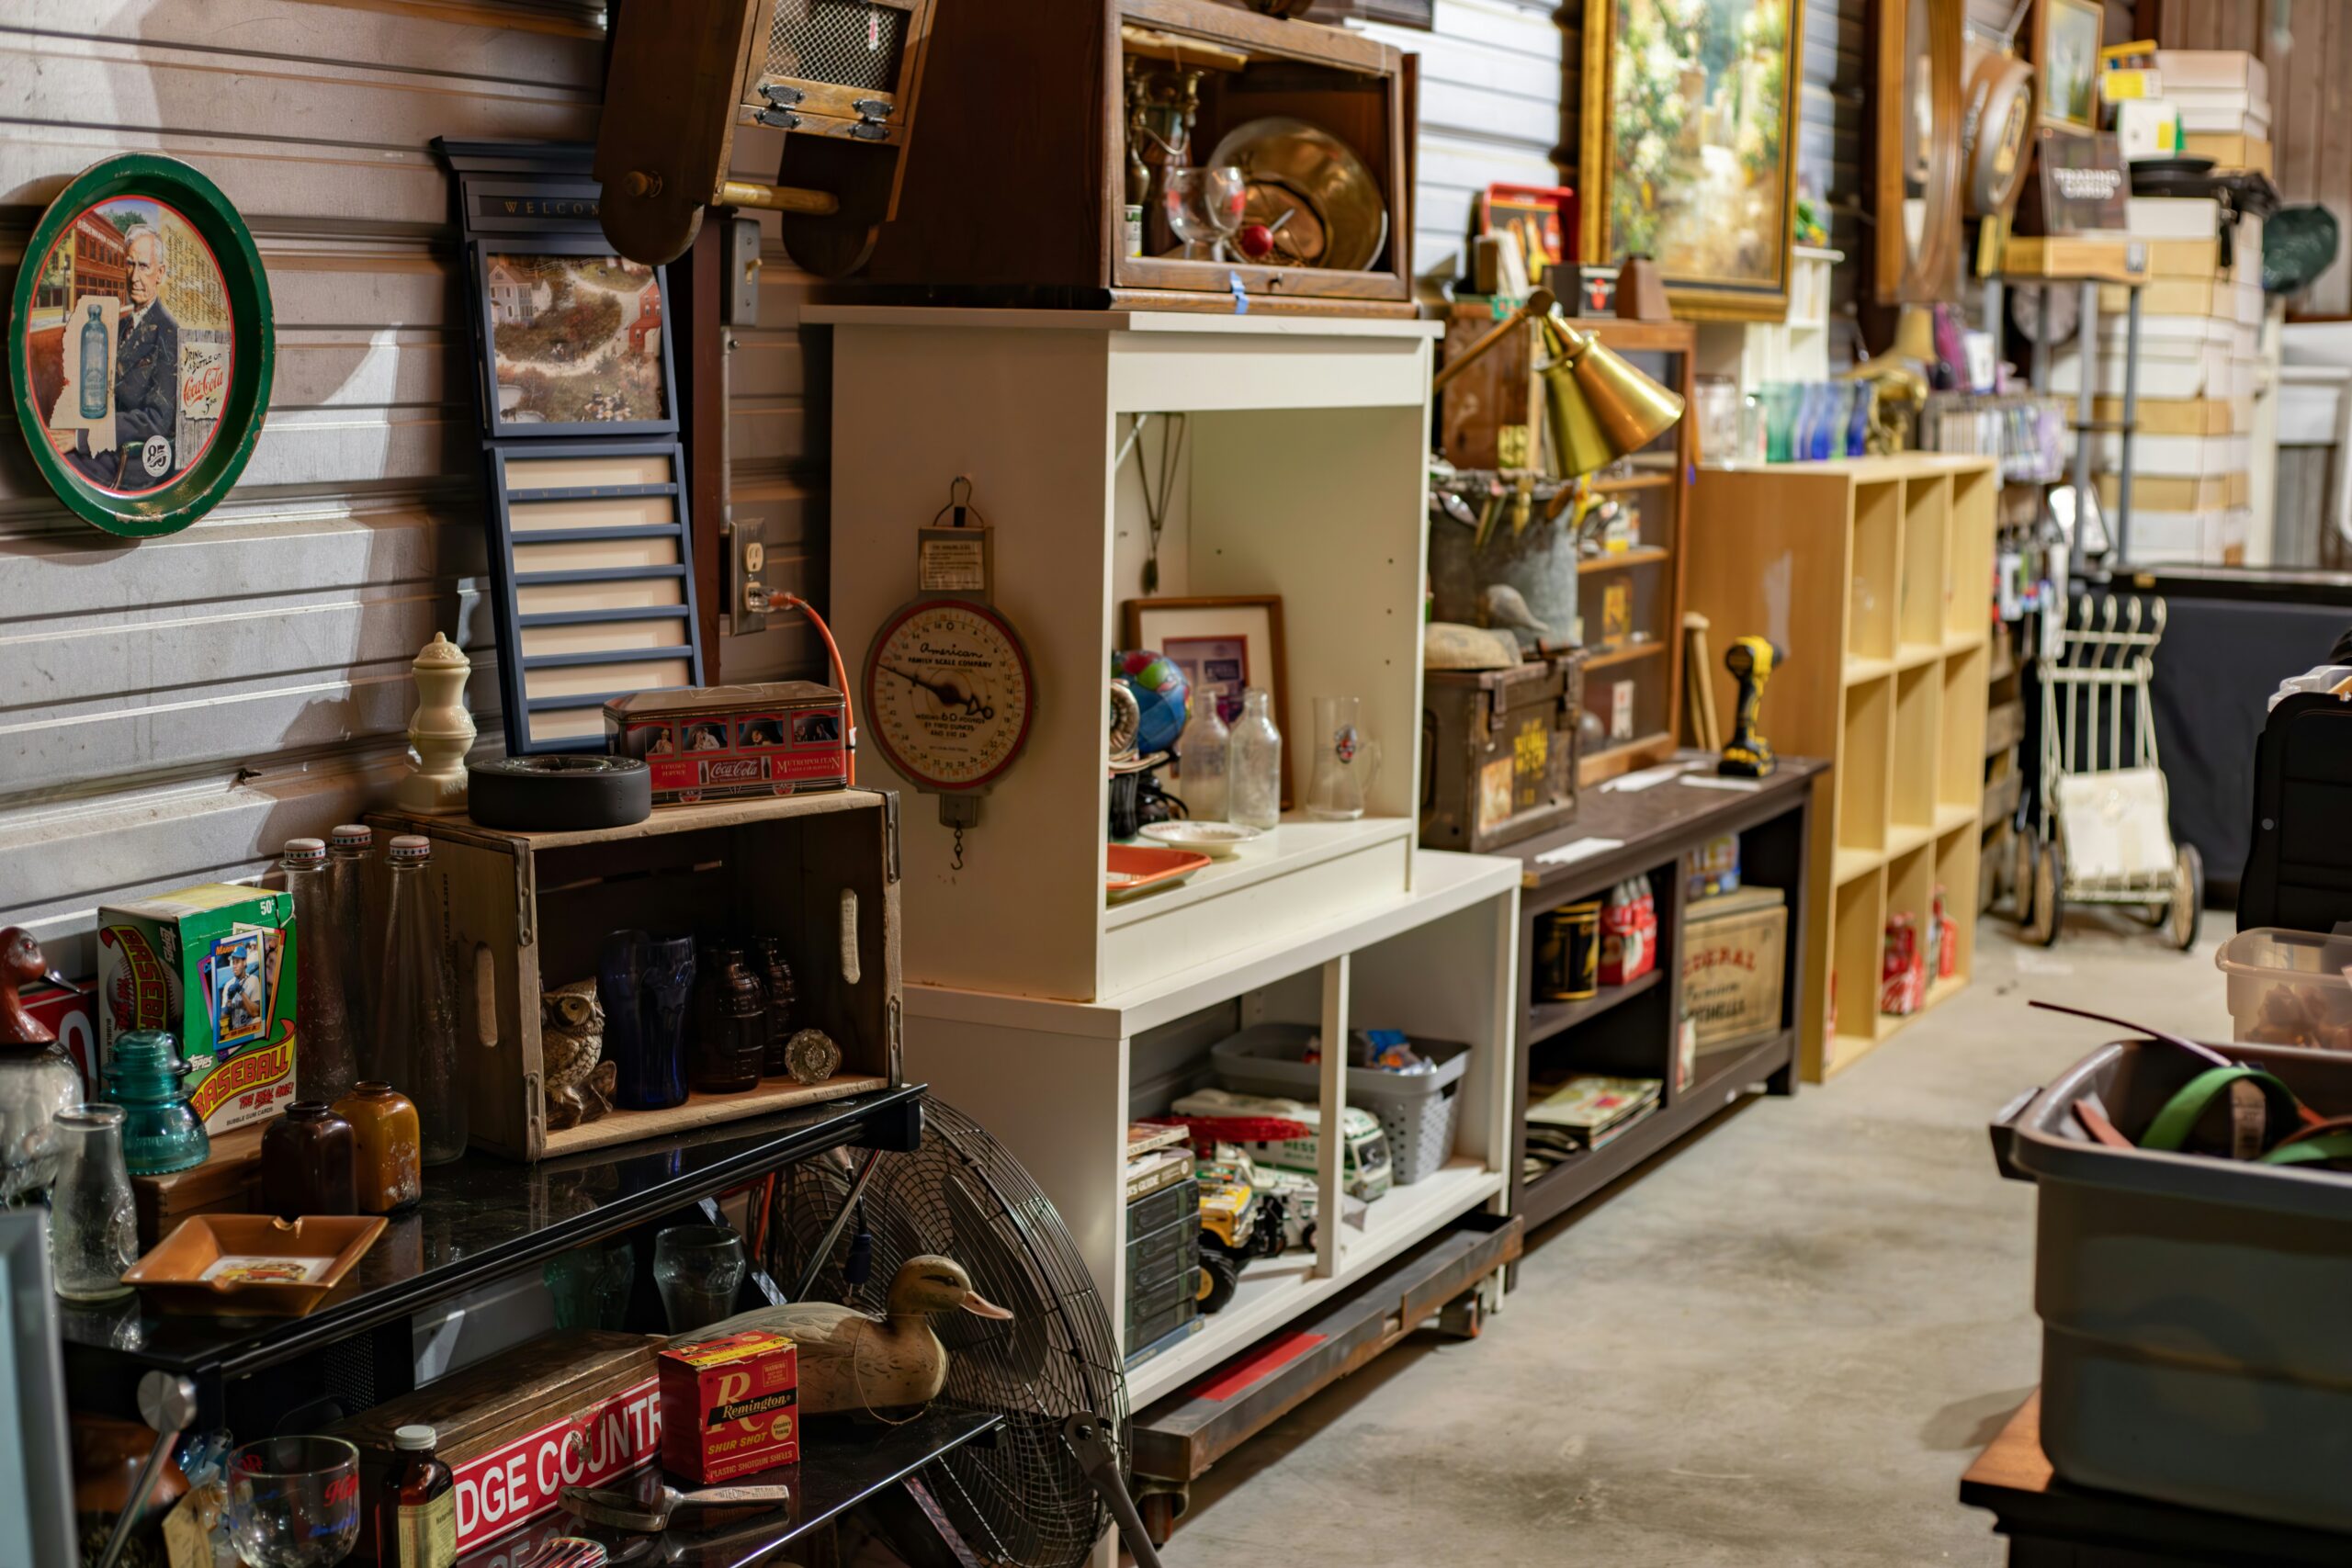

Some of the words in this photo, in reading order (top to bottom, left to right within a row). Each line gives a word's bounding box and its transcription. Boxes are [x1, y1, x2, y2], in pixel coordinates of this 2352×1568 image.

[2053, 168, 2120, 186] TRADING
[2061, 184, 2114, 199] CARDS
[505, 200, 600, 215] WELCOM
[184, 365, 223, 407] Coca-Cola
[147, 445, 167, 468] 85
[920, 642, 983, 659] American
[935, 658, 956, 666] SCALE
[957, 659, 993, 669] COMPANY
[941, 712, 957, 722] 60
[710, 760, 758, 777] Coca-Cola
[776, 756, 840, 773] METROPOLITAN
[118, 929, 164, 1030] BASEBA
[187, 1054, 213, 1072] Topps
[191, 1044, 288, 1118] BASEBALL
[239, 1093, 254, 1110] THE
[226, 1115, 245, 1126] BUBBLE
[245, 1111, 257, 1120] GUM
[257, 1107, 273, 1116] CARDS
[722, 1394, 787, 1420] Remington
[707, 1440, 737, 1455] SHUR
[740, 1431, 768, 1447] SHOT
[456, 1453, 529, 1537] DGE
[537, 1391, 662, 1495] COUNTR
[710, 1465, 737, 1478] PLASTIC
[738, 1458, 769, 1471] SHOTGUN
[770, 1450, 793, 1463] SHELLS
